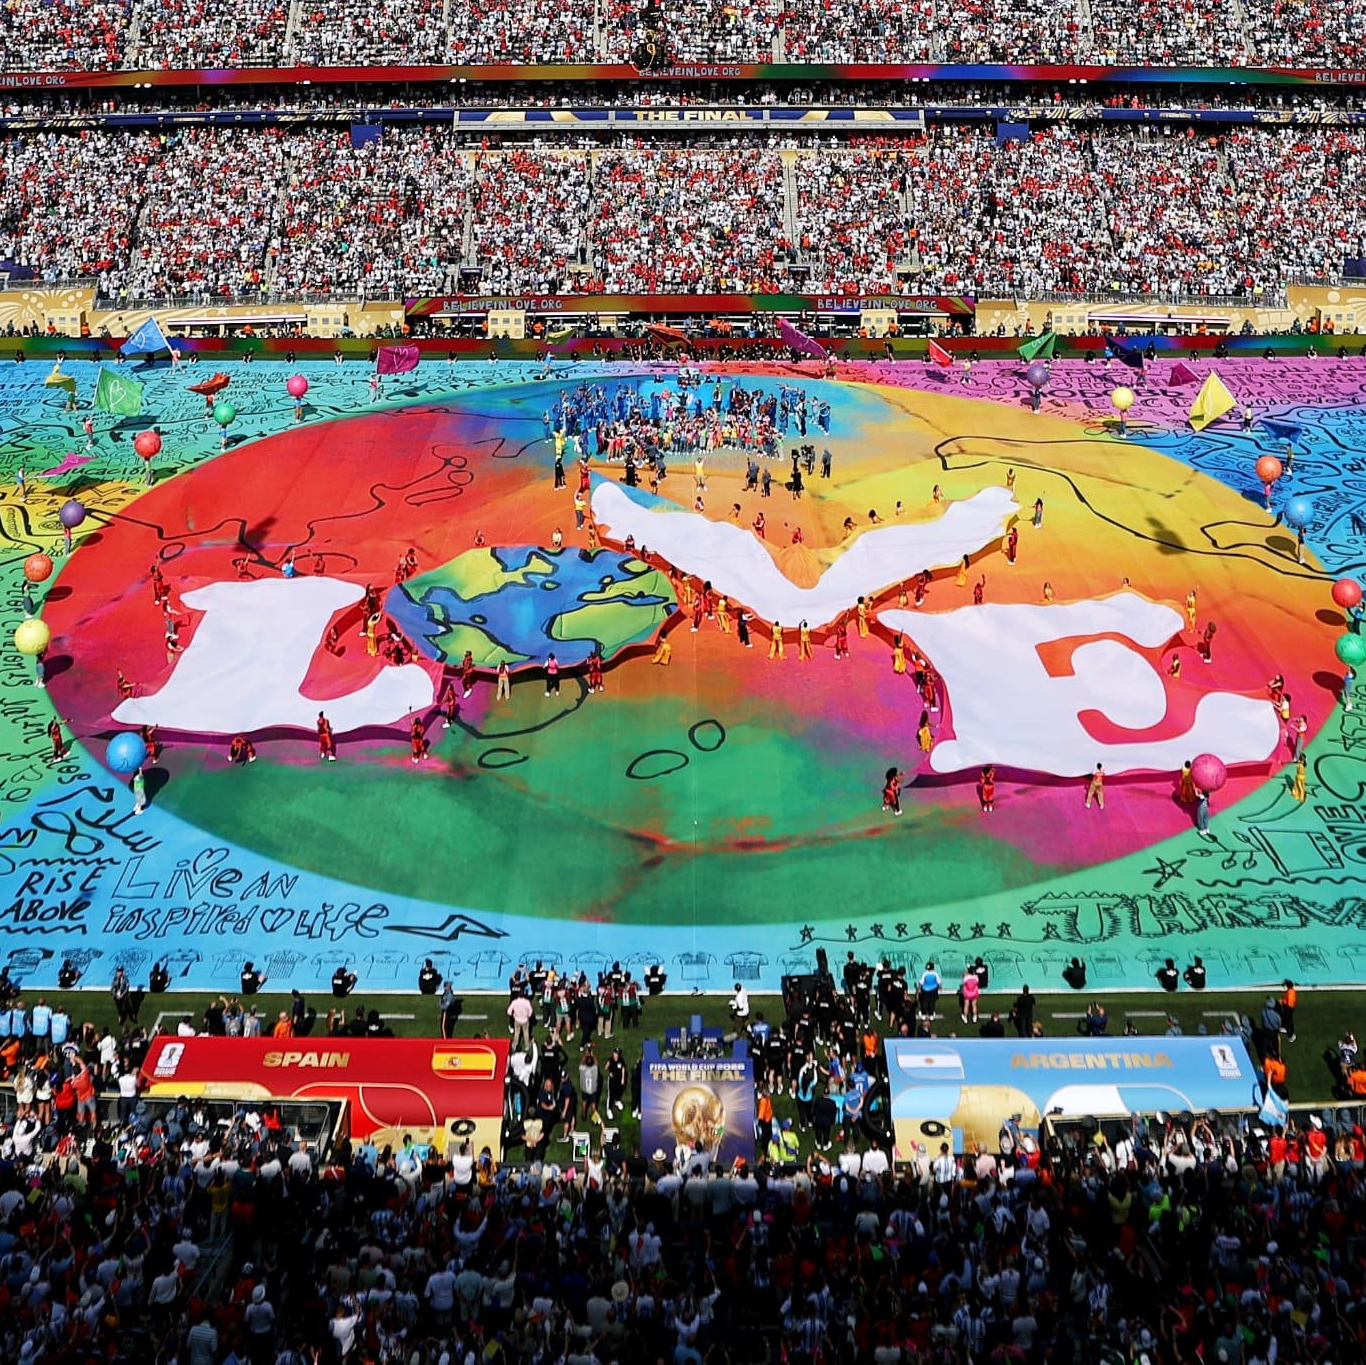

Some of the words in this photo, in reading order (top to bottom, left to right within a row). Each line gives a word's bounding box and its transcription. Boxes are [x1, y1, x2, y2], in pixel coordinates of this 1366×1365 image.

[633, 111, 681, 121] THE
[684, 111, 755, 121] FINAL
[443, 299, 563, 311] BELIEVEINLOVE.ORG
[817, 298, 938, 310] BELIEVEINLOVE.ORG
[263, 1051, 350, 1068] SPAIN
[1010, 1052, 1174, 1068] ARGENTINA
[649, 1063, 667, 1071] FIFA
[668, 1063, 698, 1071] WORLD
[699, 1063, 715, 1071] CUP
[716, 1063, 746, 1071] 2026
[650, 1070, 688, 1082] THE
[690, 1070, 746, 1082] FINAL
